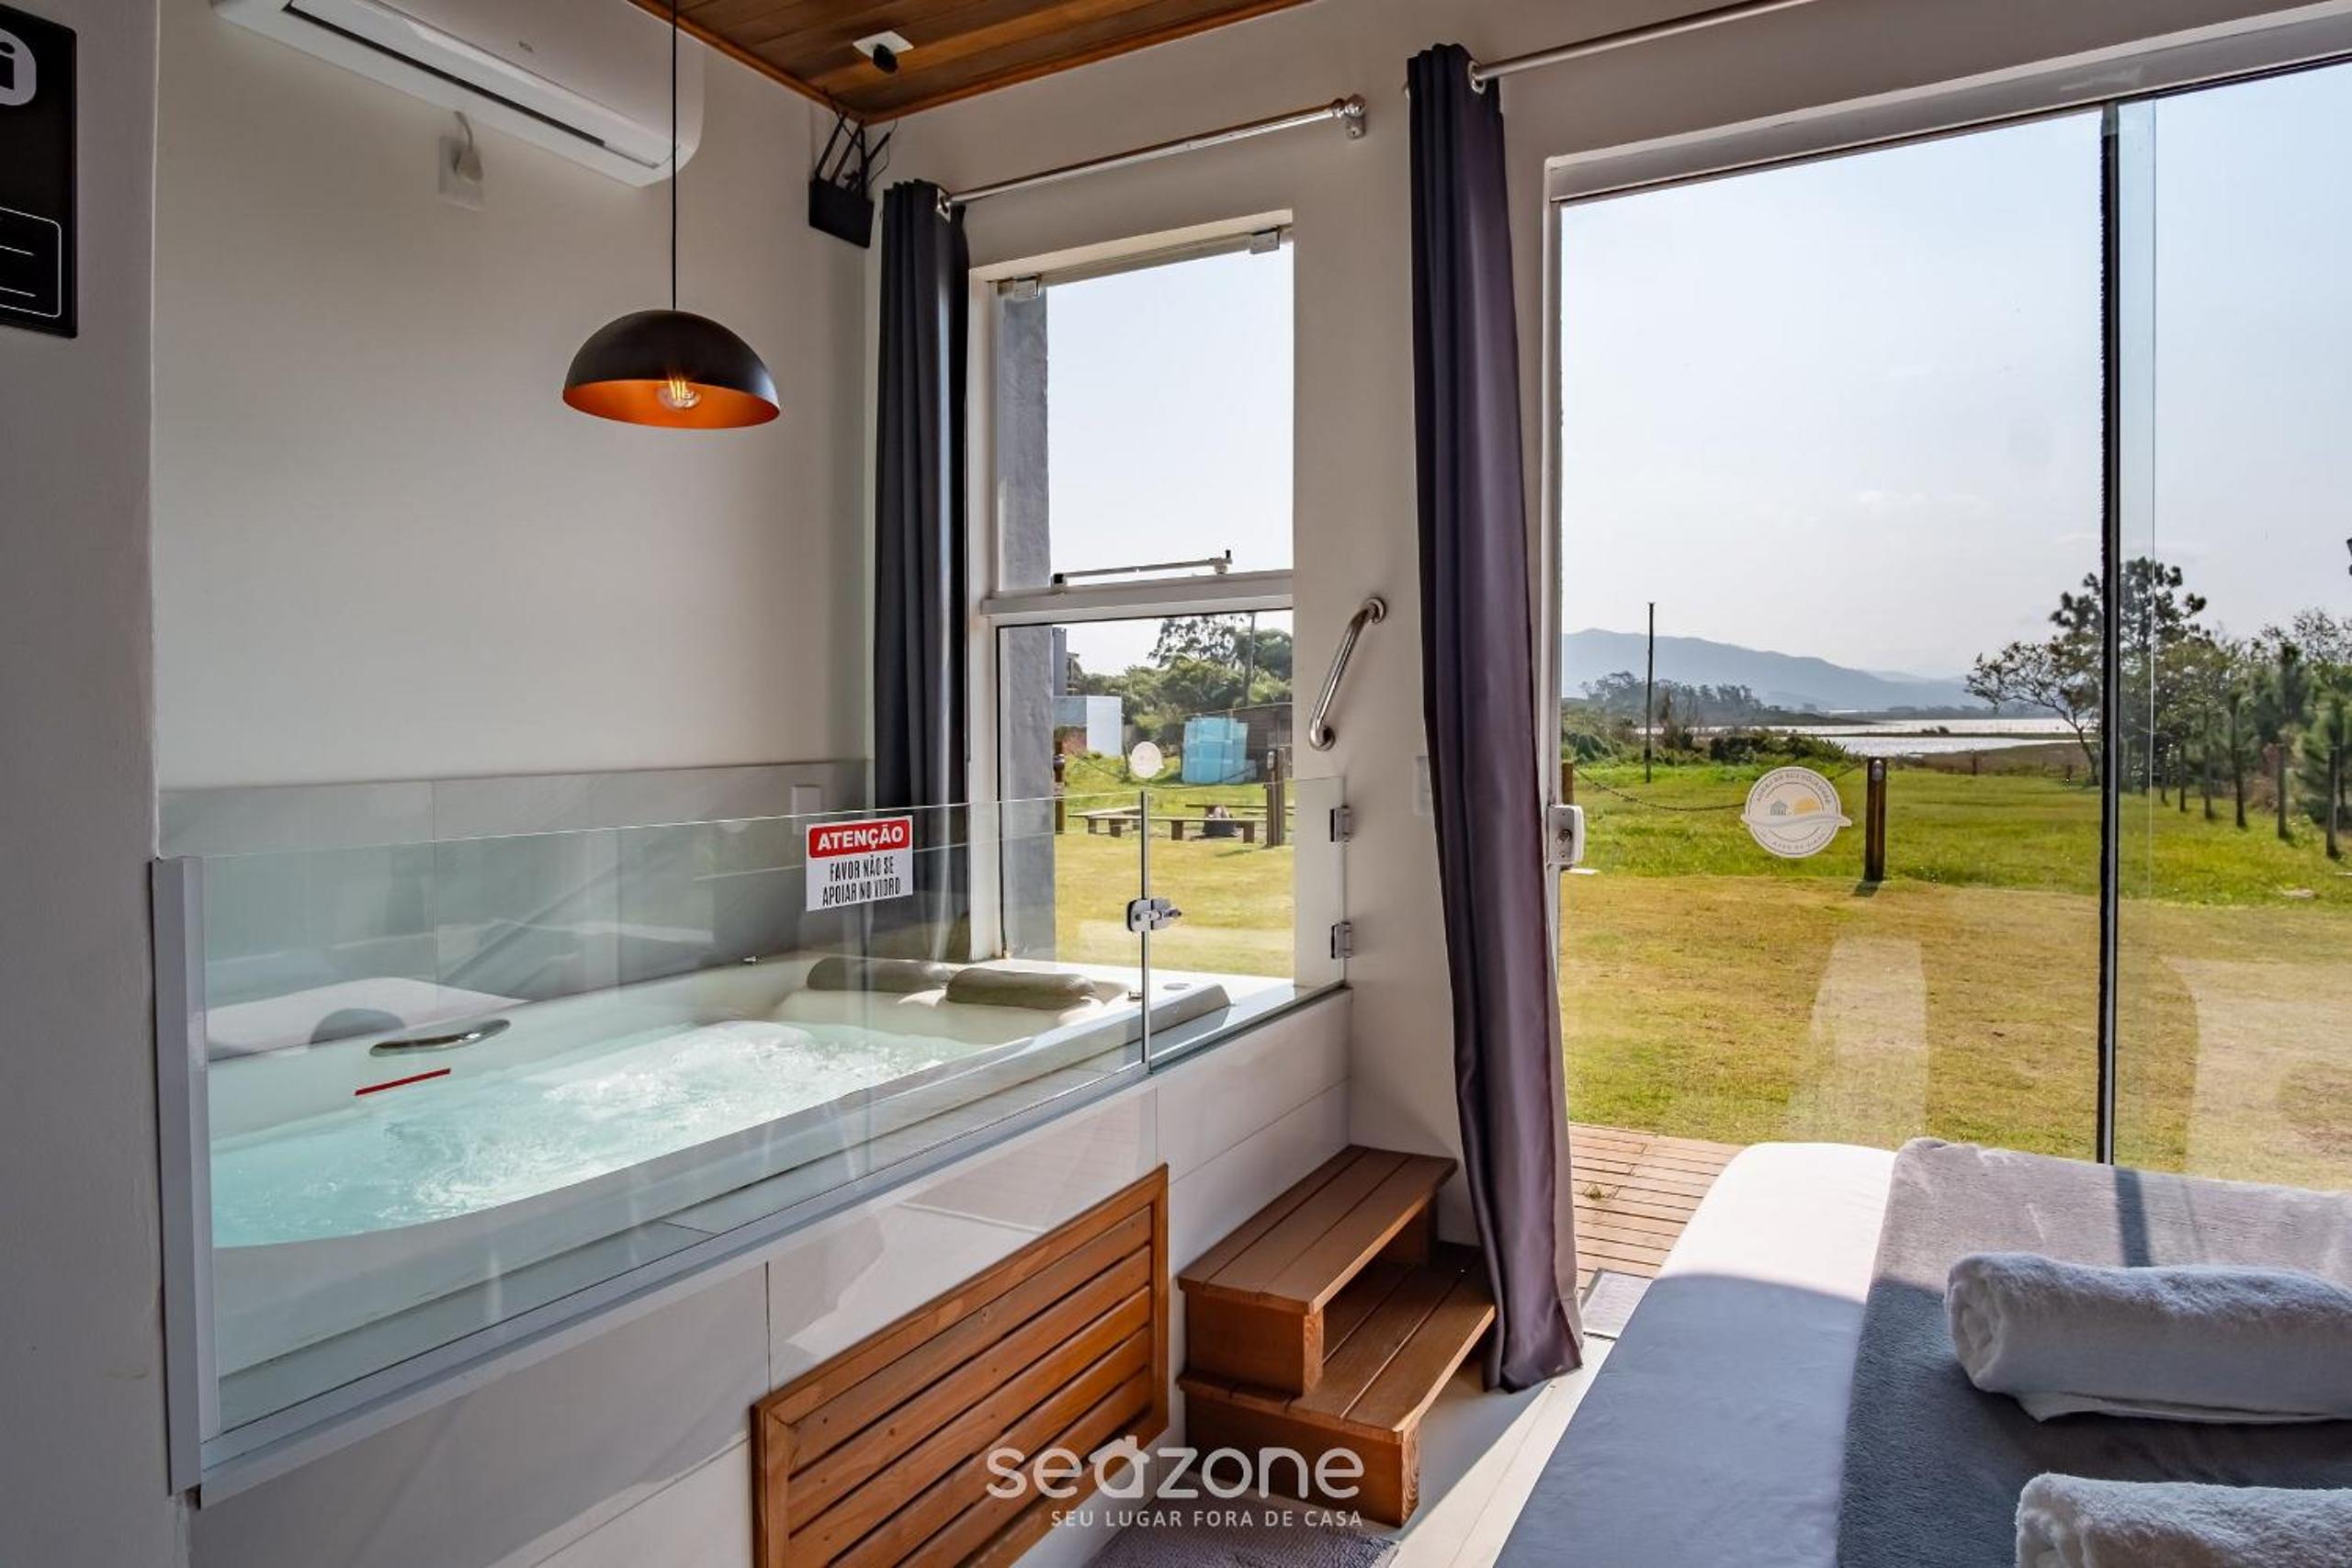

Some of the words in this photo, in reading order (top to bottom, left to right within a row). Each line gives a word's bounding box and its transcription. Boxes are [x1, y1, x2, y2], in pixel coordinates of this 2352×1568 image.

[818, 825, 904, 850] ATENÇÃO
[831, 861, 860, 882] FAVOR
[864, 855, 881, 876] NÃO
[884, 856, 895, 874] SE
[822, 884, 857, 906] APOIAR
[860, 881, 872, 899] NO
